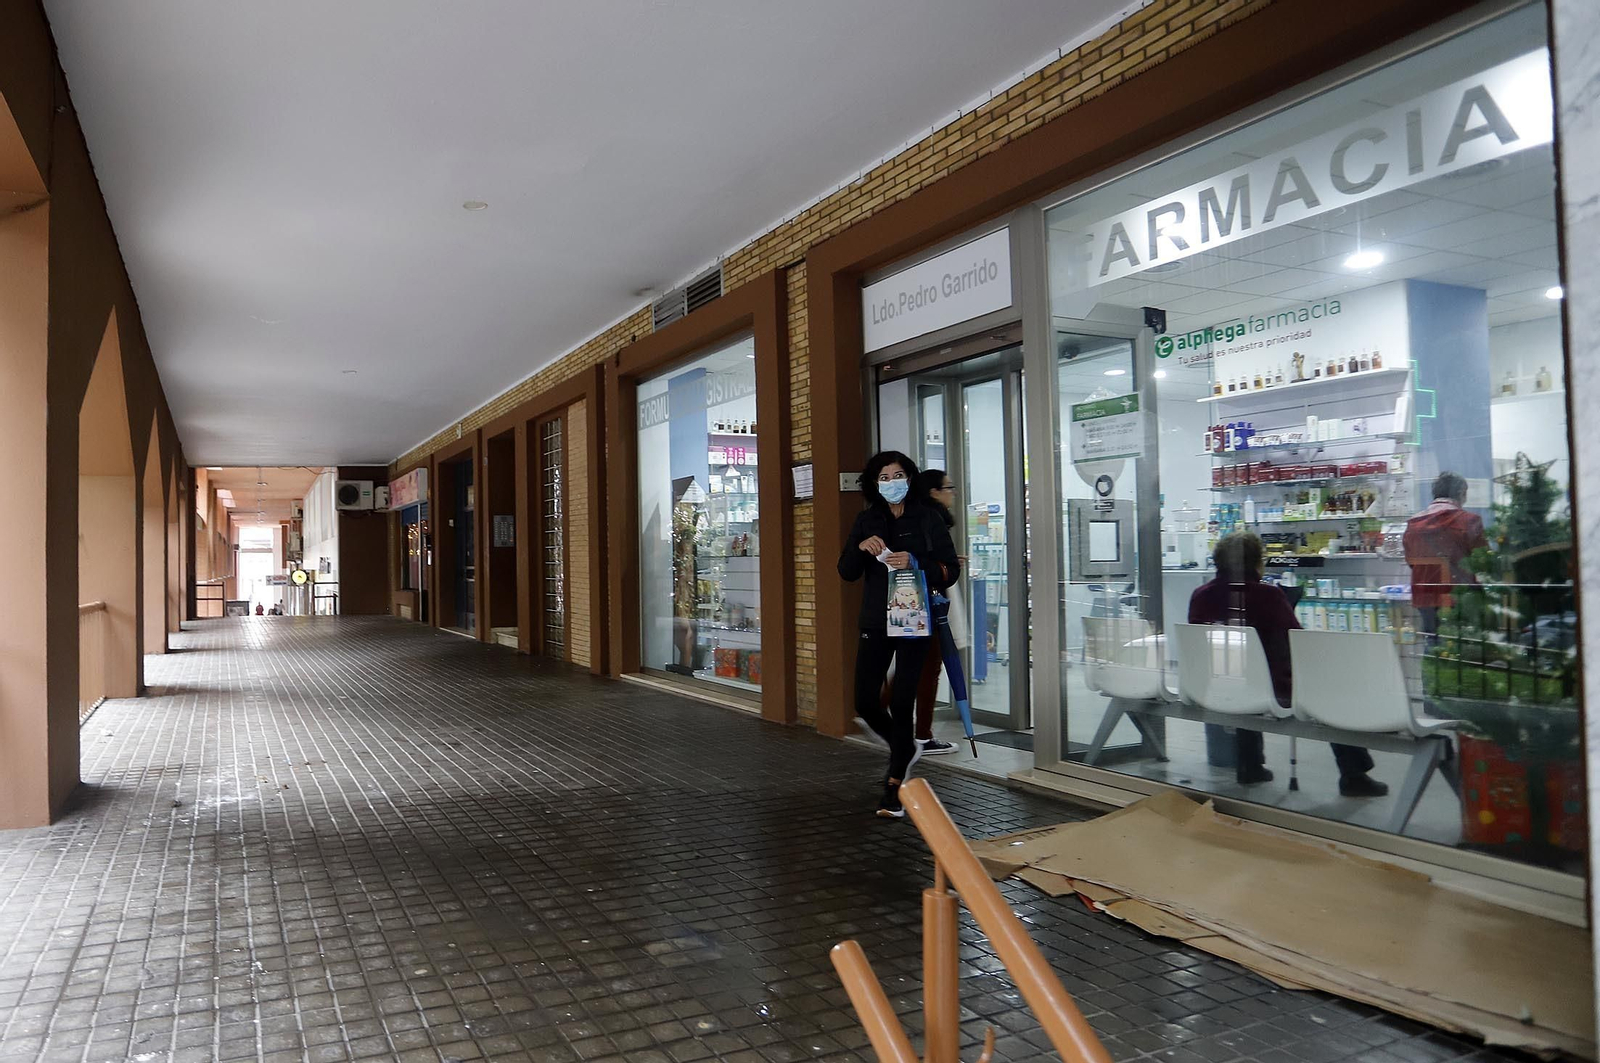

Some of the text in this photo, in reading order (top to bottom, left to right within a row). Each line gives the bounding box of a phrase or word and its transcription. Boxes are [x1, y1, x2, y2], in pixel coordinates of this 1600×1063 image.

[872, 258, 998, 325] Ldo.Pedro Garrido
[1177, 298, 1342, 350] alphega farmacia
[1178, 328, 1312, 366] Tu salud es nuestra prioridad
